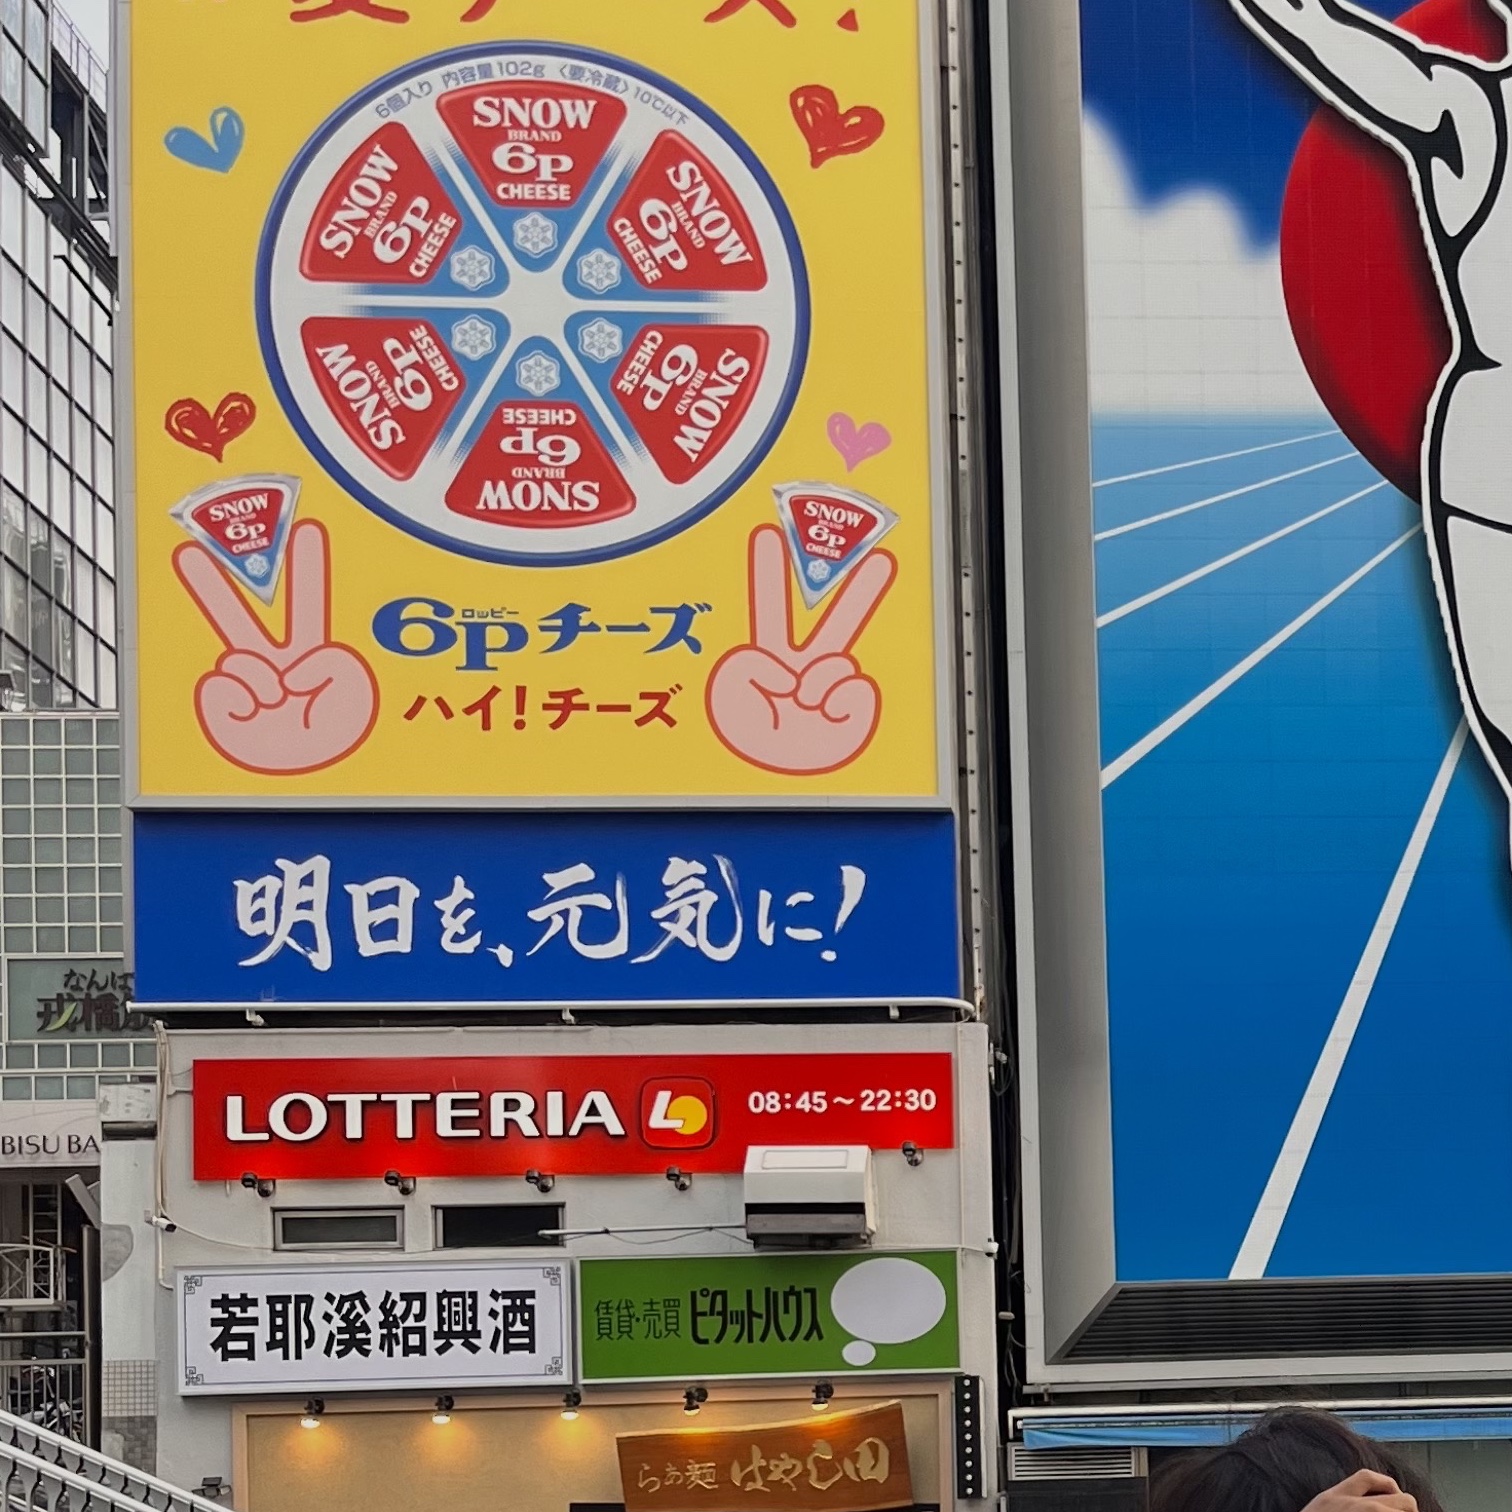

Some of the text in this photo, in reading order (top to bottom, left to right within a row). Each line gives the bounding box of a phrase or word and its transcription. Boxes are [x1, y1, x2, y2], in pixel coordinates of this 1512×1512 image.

[473, 96, 598, 129] SNOW
[319, 144, 400, 260] SNOW
[496, 183, 571, 201] CHEESE
[665, 160, 753, 266] SNOW
[409, 213, 457, 279] CHEESE
[613, 217, 663, 284] CHEESE
[408, 324, 460, 392] CHEESE
[616, 330, 664, 396] CHEESE
[315, 343, 407, 450] SNOW
[502, 408, 577, 426] CHEESE
[673, 348, 751, 463] SNOW
[208, 492, 269, 523] SNOW
[476, 480, 600, 511] SNOW
[803, 500, 865, 528] SNOW
[403, 683, 684, 731] ハイ!チーズ
[233, 853, 867, 971] 明日を、元気に!
[225, 1091, 625, 1142] LOTTERIA
[208, 1288, 538, 1362] 若耶溪紹興酒
[594, 1285, 824, 1345] 賃貸・売買 ピタットハウス
